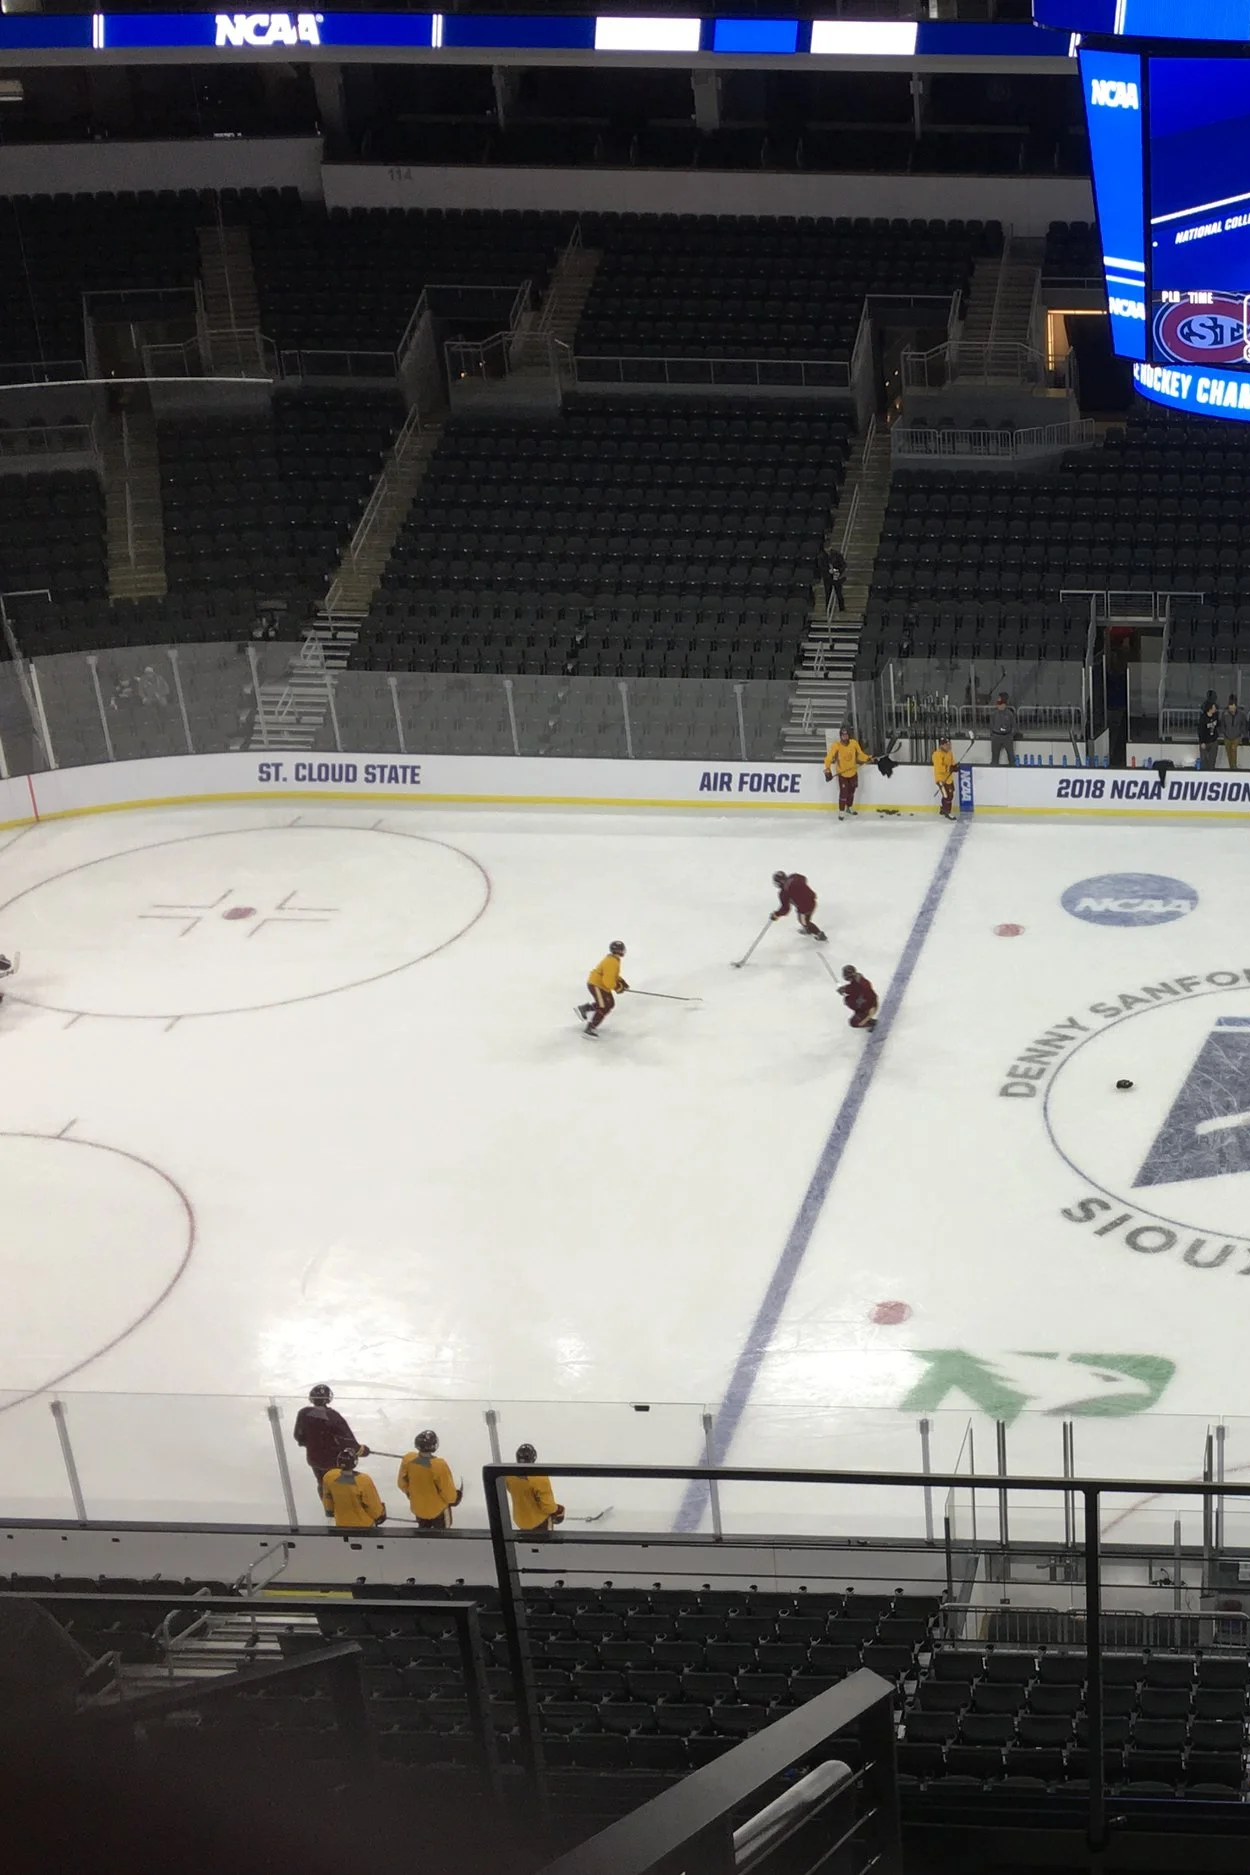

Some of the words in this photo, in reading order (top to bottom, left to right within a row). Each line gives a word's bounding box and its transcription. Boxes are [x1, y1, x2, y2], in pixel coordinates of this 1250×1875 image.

[215, 14, 321, 45] NCAA
[1091, 78, 1139, 110] NCAA
[1175, 219, 1223, 245] NATIONAL
[1108, 296, 1146, 321] NCAA
[1187, 291, 1214, 304] TIME
[1140, 363, 1193, 400] HOCKEY
[258, 762, 287, 783] ST.
[294, 762, 357, 783] CLOUD
[364, 764, 421, 785] STATE
[699, 771, 732, 792] AIR
[738, 772, 801, 793] FORCE
[960, 769, 972, 801] NCAA
[1056, 778, 1104, 799] 2018
[1110, 780, 1163, 800] NCAA
[1073, 897, 1192, 914] NCAA
[999, 1016, 1090, 1098] DENNY
